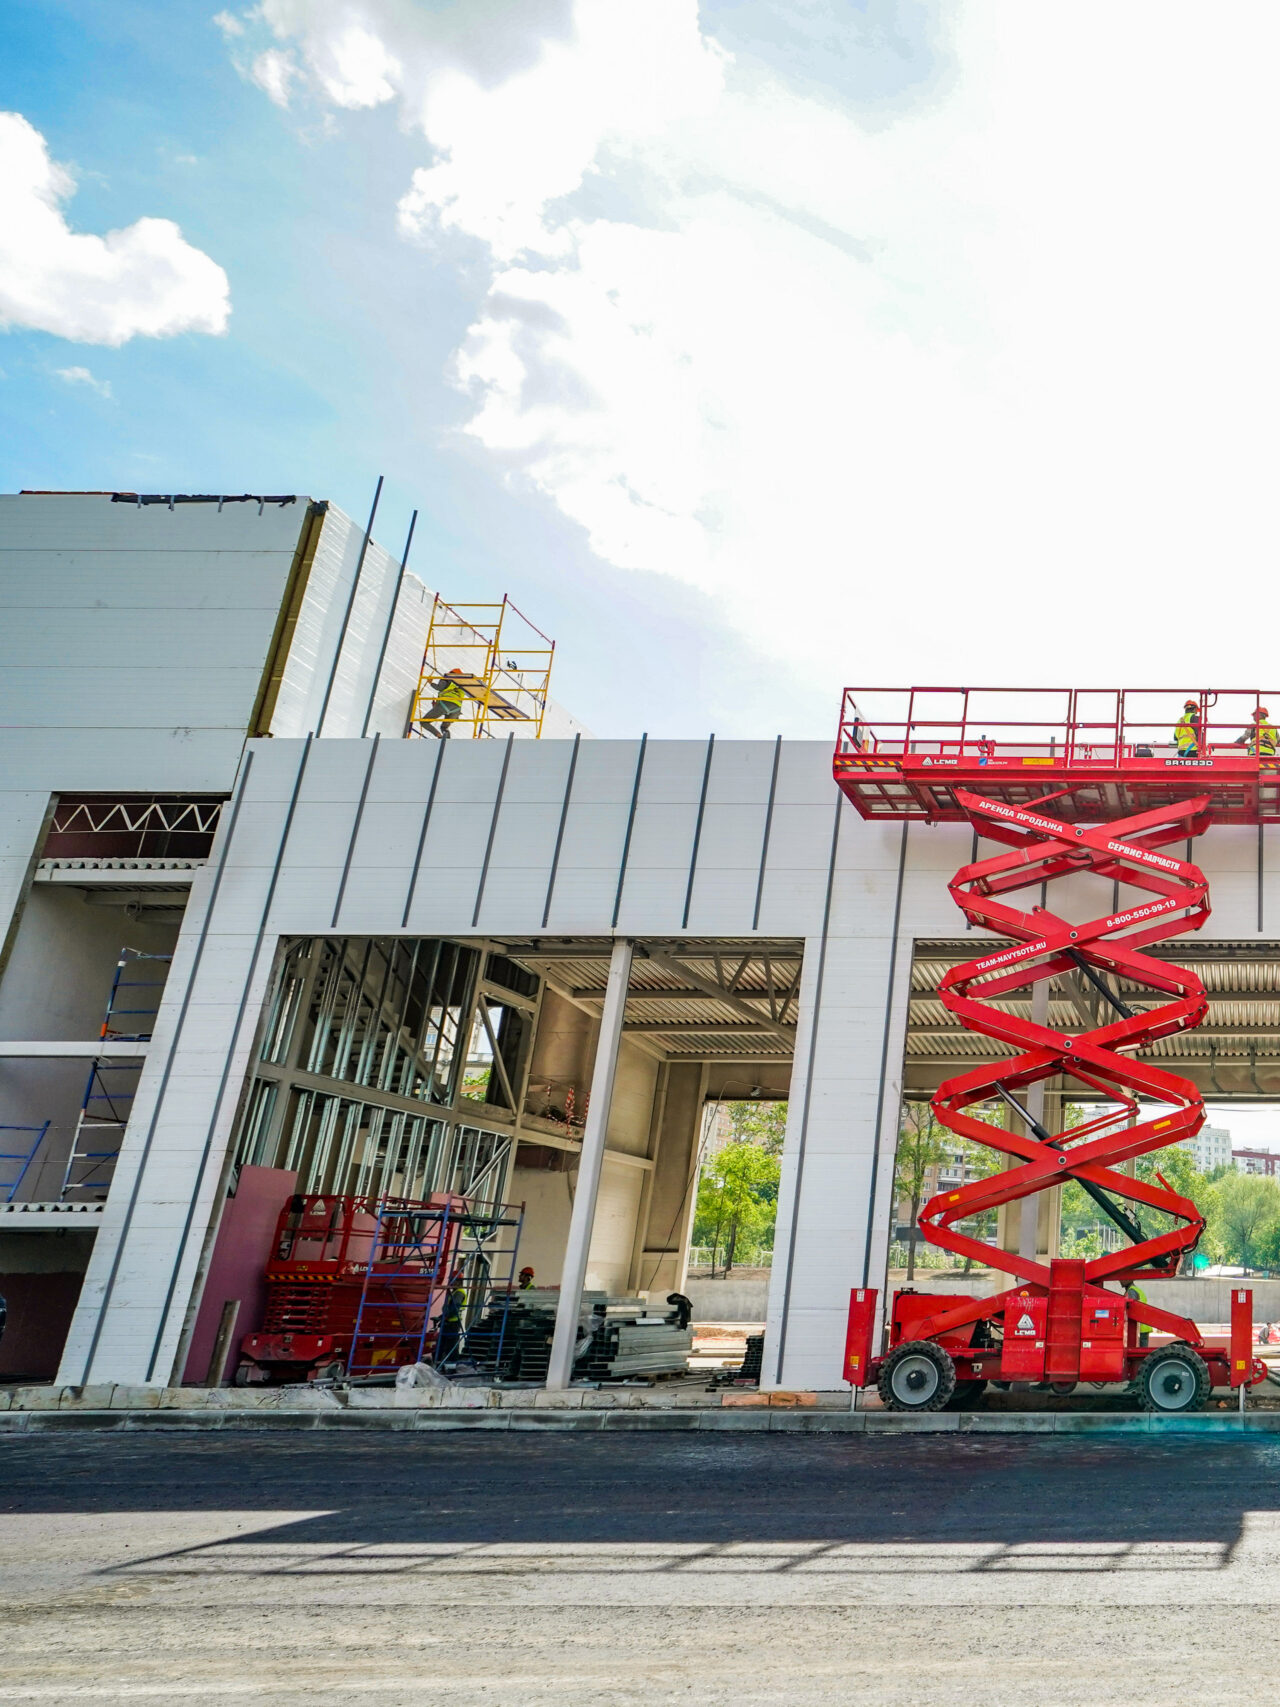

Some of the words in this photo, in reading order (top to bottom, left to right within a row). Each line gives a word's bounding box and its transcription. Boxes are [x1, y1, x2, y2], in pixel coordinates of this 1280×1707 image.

[979, 801, 1015, 817] АРЕНДА
[1016, 812, 1063, 832] ПРОДАЖА
[1107, 841, 1143, 859] СЕРВИС
[1142, 852, 1181, 871] ЗАПЧАСТИ
[1106, 899, 1177, 927] 8-800-550-99-19
[975, 941, 1047, 970] TEAM-NAVYSOTE.RU
